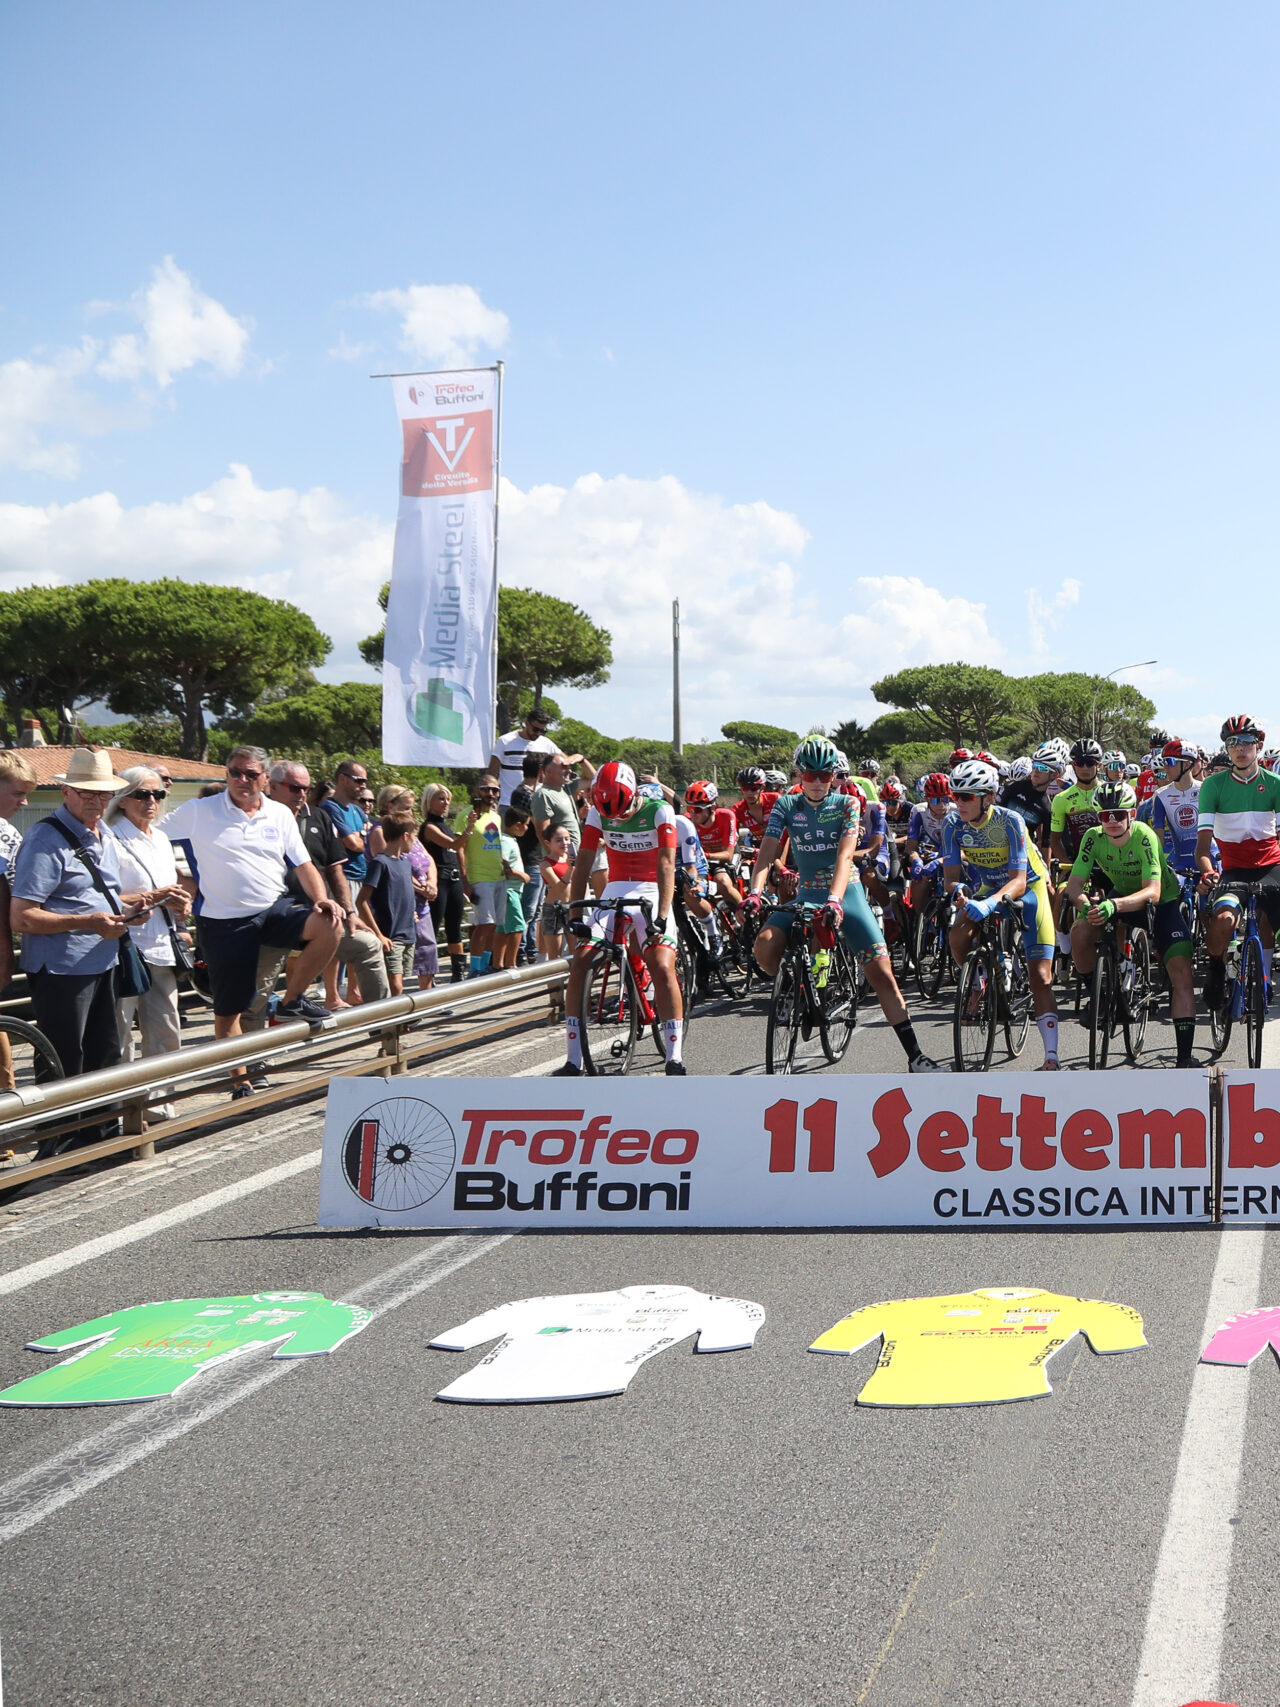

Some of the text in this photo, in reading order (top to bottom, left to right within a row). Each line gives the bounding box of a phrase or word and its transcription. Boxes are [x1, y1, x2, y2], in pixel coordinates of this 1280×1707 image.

[434, 384, 475, 395] Trofeo
[434, 391, 484, 405] Buffoni
[429, 503, 465, 669] Media Steel
[461, 1109, 699, 1165] Trofeo
[763, 1097, 838, 1173] 11
[453, 1171, 691, 1211] Buffoni
[933, 1186, 1129, 1218] CLASSICA
